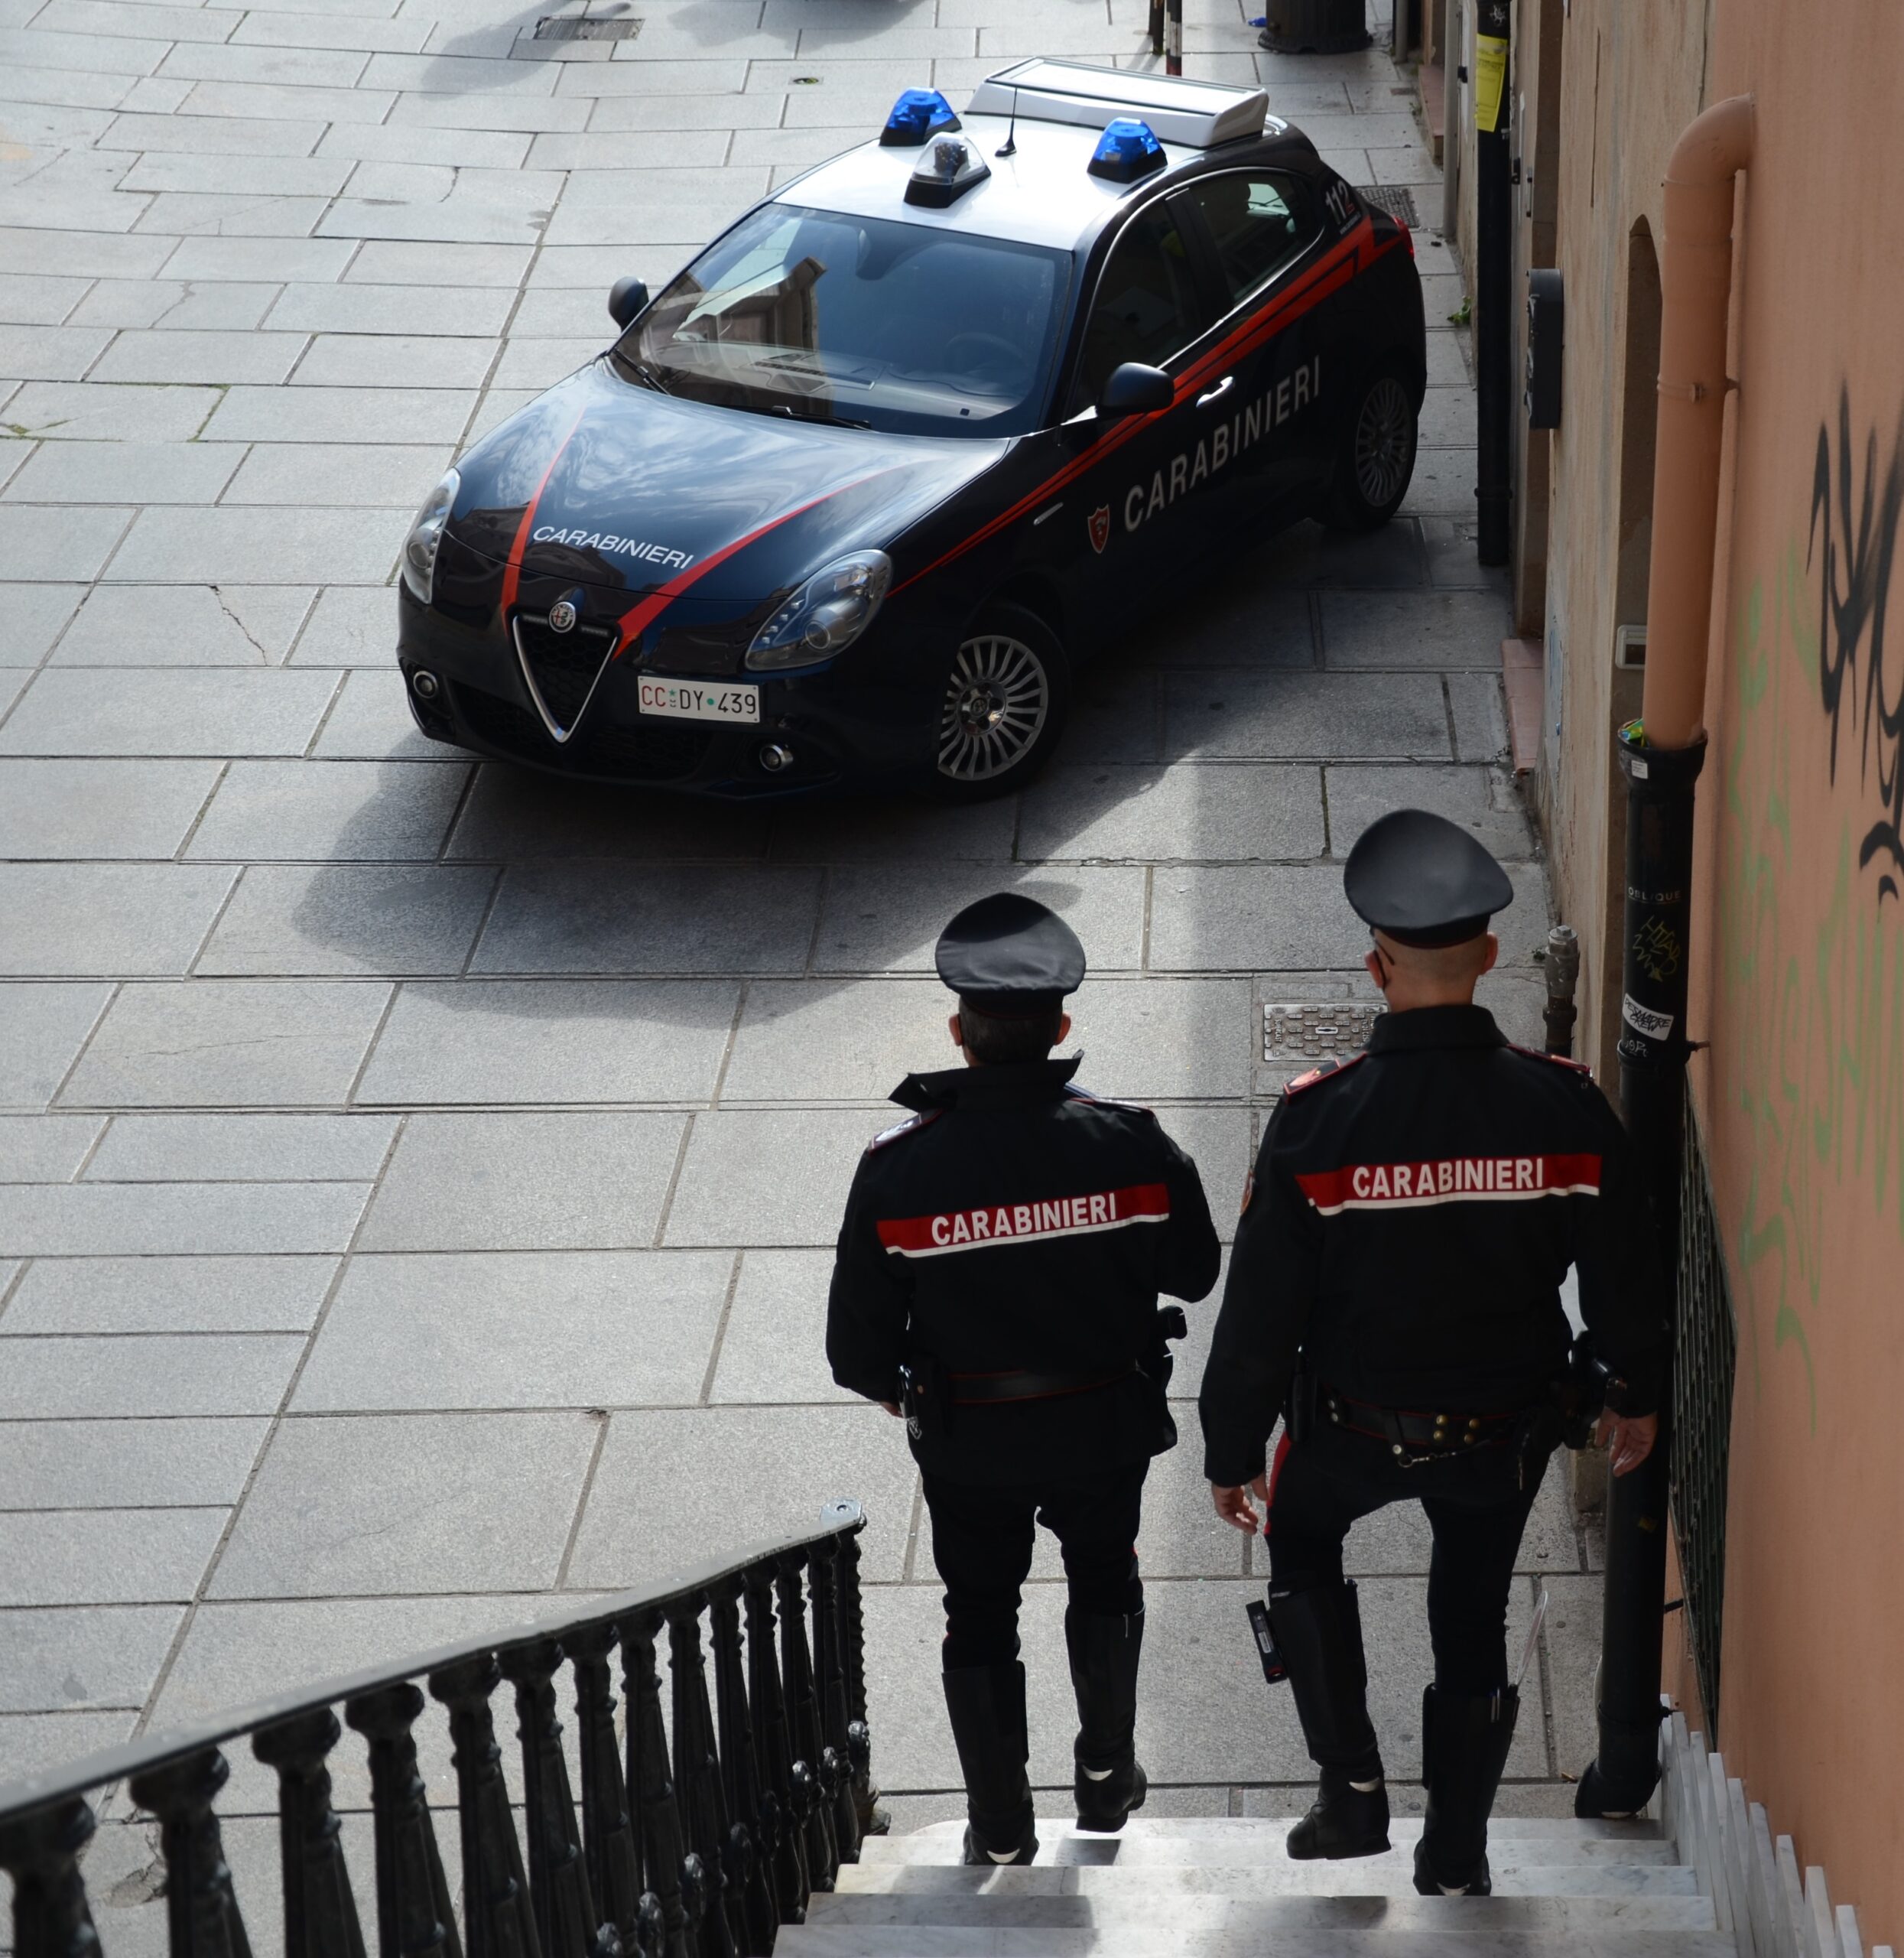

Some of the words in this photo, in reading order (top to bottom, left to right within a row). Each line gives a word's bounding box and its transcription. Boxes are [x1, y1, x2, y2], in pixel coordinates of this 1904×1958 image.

[1325, 180, 1356, 225] 112
[1125, 355, 1319, 532] CARABINIERI
[533, 526, 694, 569] CARABINIERI
[642, 685, 666, 707] CC
[680, 689, 703, 711] DY
[718, 692, 756, 714] 439
[1628, 886, 1681, 902] OBLIQUE
[1352, 1158, 1543, 1199] CARABINIERI
[931, 1192, 1116, 1246] CARABINIERI
